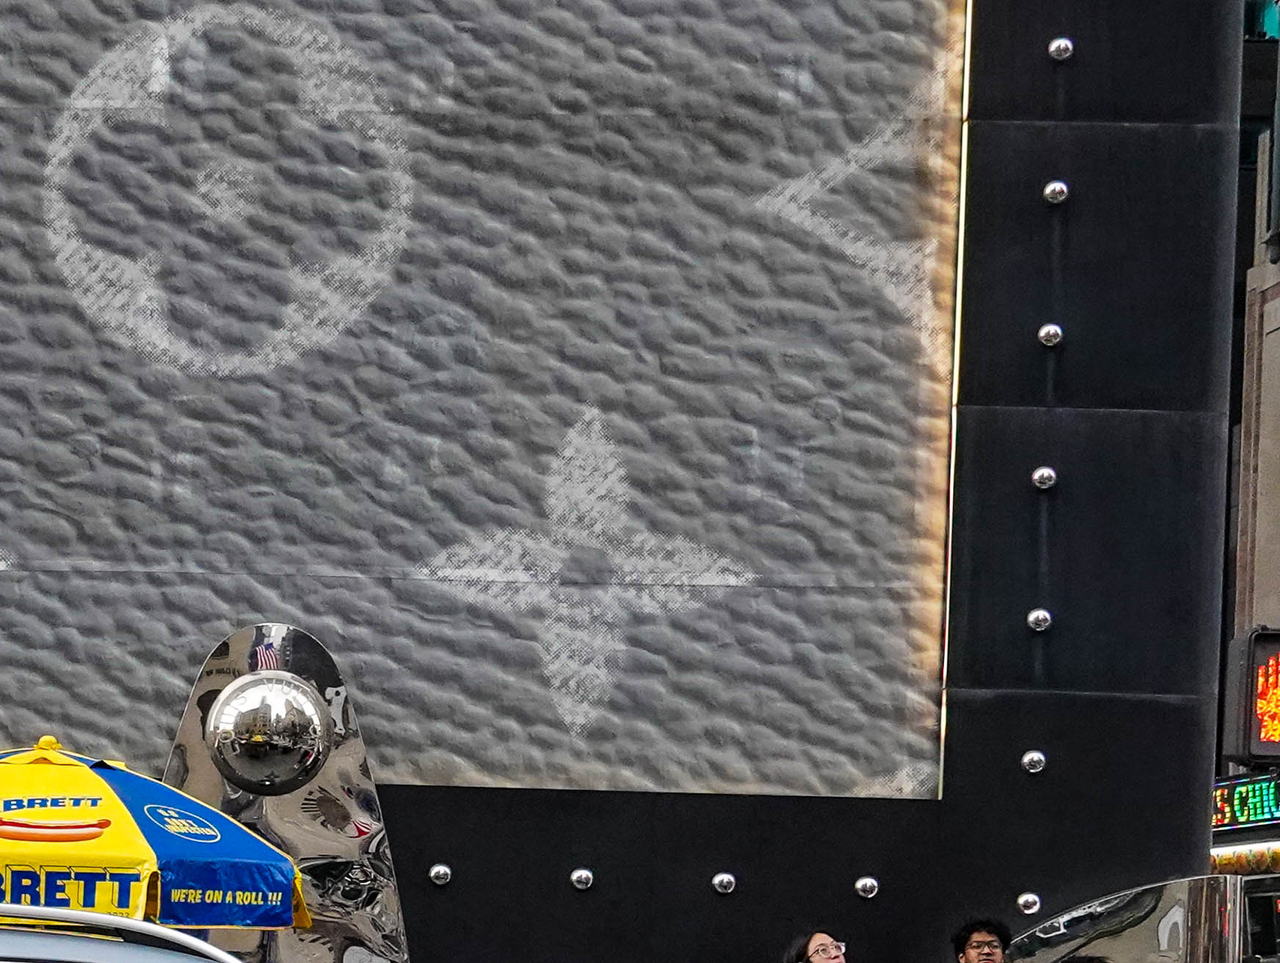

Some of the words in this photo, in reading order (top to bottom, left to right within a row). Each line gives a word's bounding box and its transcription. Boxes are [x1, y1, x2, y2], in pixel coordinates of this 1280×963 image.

[171, 888, 202, 904] WE'RE
[205, 890, 223, 904] ON
[226, 891, 233, 904] A
[236, 891, 264, 905] ROLL
